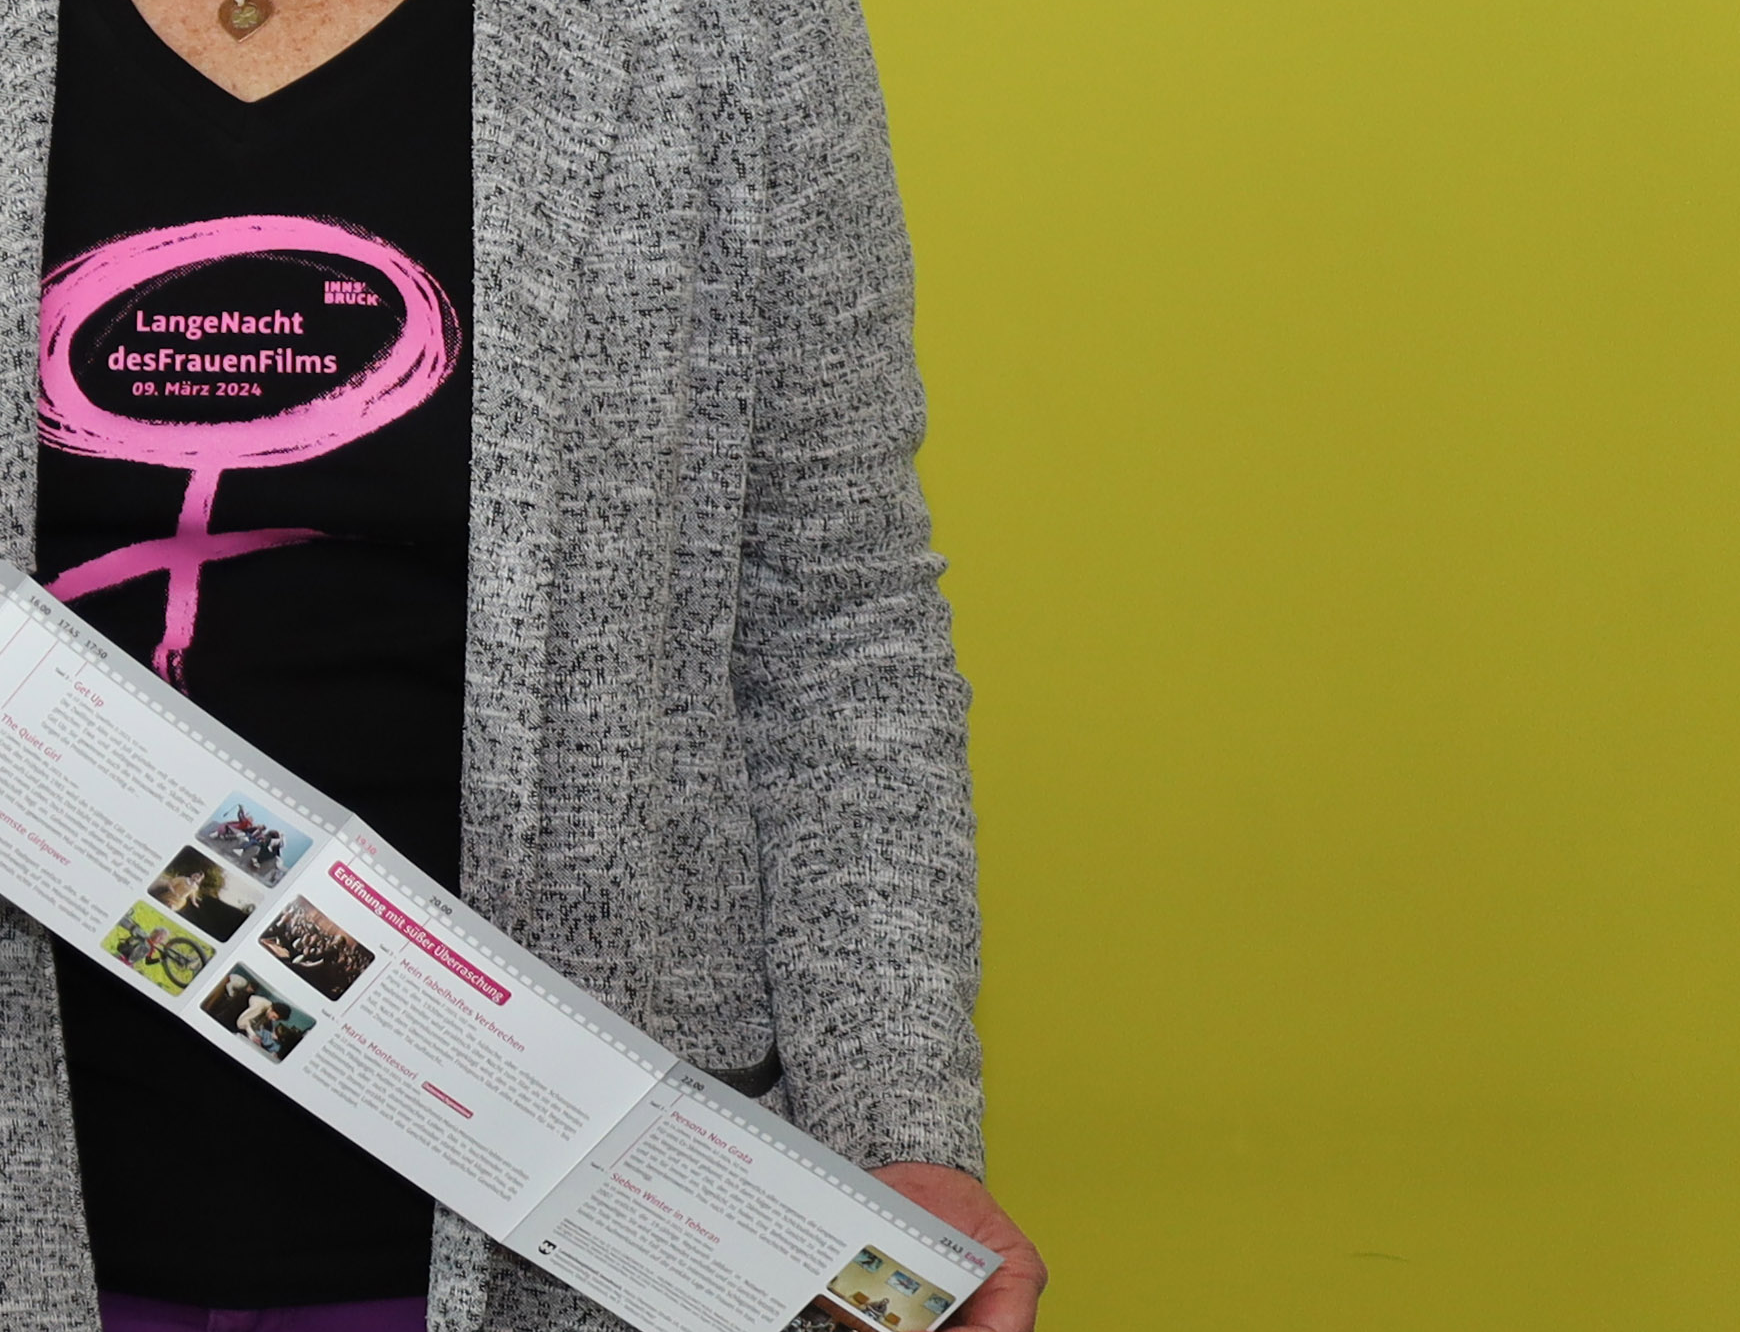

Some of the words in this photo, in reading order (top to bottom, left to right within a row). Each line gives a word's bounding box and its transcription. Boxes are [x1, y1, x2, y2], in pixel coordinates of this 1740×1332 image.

[324, 292, 379, 306] BRUCK
[136, 309, 304, 339] LangeNacht
[107, 346, 338, 375] desFrauenFilms
[132, 382, 160, 397] 09.
[164, 380, 212, 397] März
[215, 382, 263, 397] 2024
[74, 681, 91, 698] Get
[90, 692, 105, 708] Up
[1, 713, 19, 730] The
[18, 727, 44, 750] Quiet
[43, 745, 63, 763] Girl
[27, 832, 72, 867] Girlpower
[333, 866, 386, 914] Eröffnung
[385, 909, 405, 928] mit
[404, 924, 435, 950] süßer
[433, 944, 505, 1003] Überraschung
[398, 958, 425, 982] Mein
[423, 974, 475, 1017] fabelhaftes
[473, 1011, 526, 1053] Verbrechen
[340, 1023, 369, 1049] Maria
[367, 1041, 419, 1080] Montessori
[670, 1110, 707, 1137] Persona
[707, 1132, 728, 1149] Non
[727, 1145, 754, 1165] Grata
[610, 1172, 642, 1195] Sieben
[641, 1192, 673, 1213] Winter
[672, 1210, 684, 1221] in
[684, 1216, 721, 1244] Teheran
[964, 1251, 986, 1267] Ende
